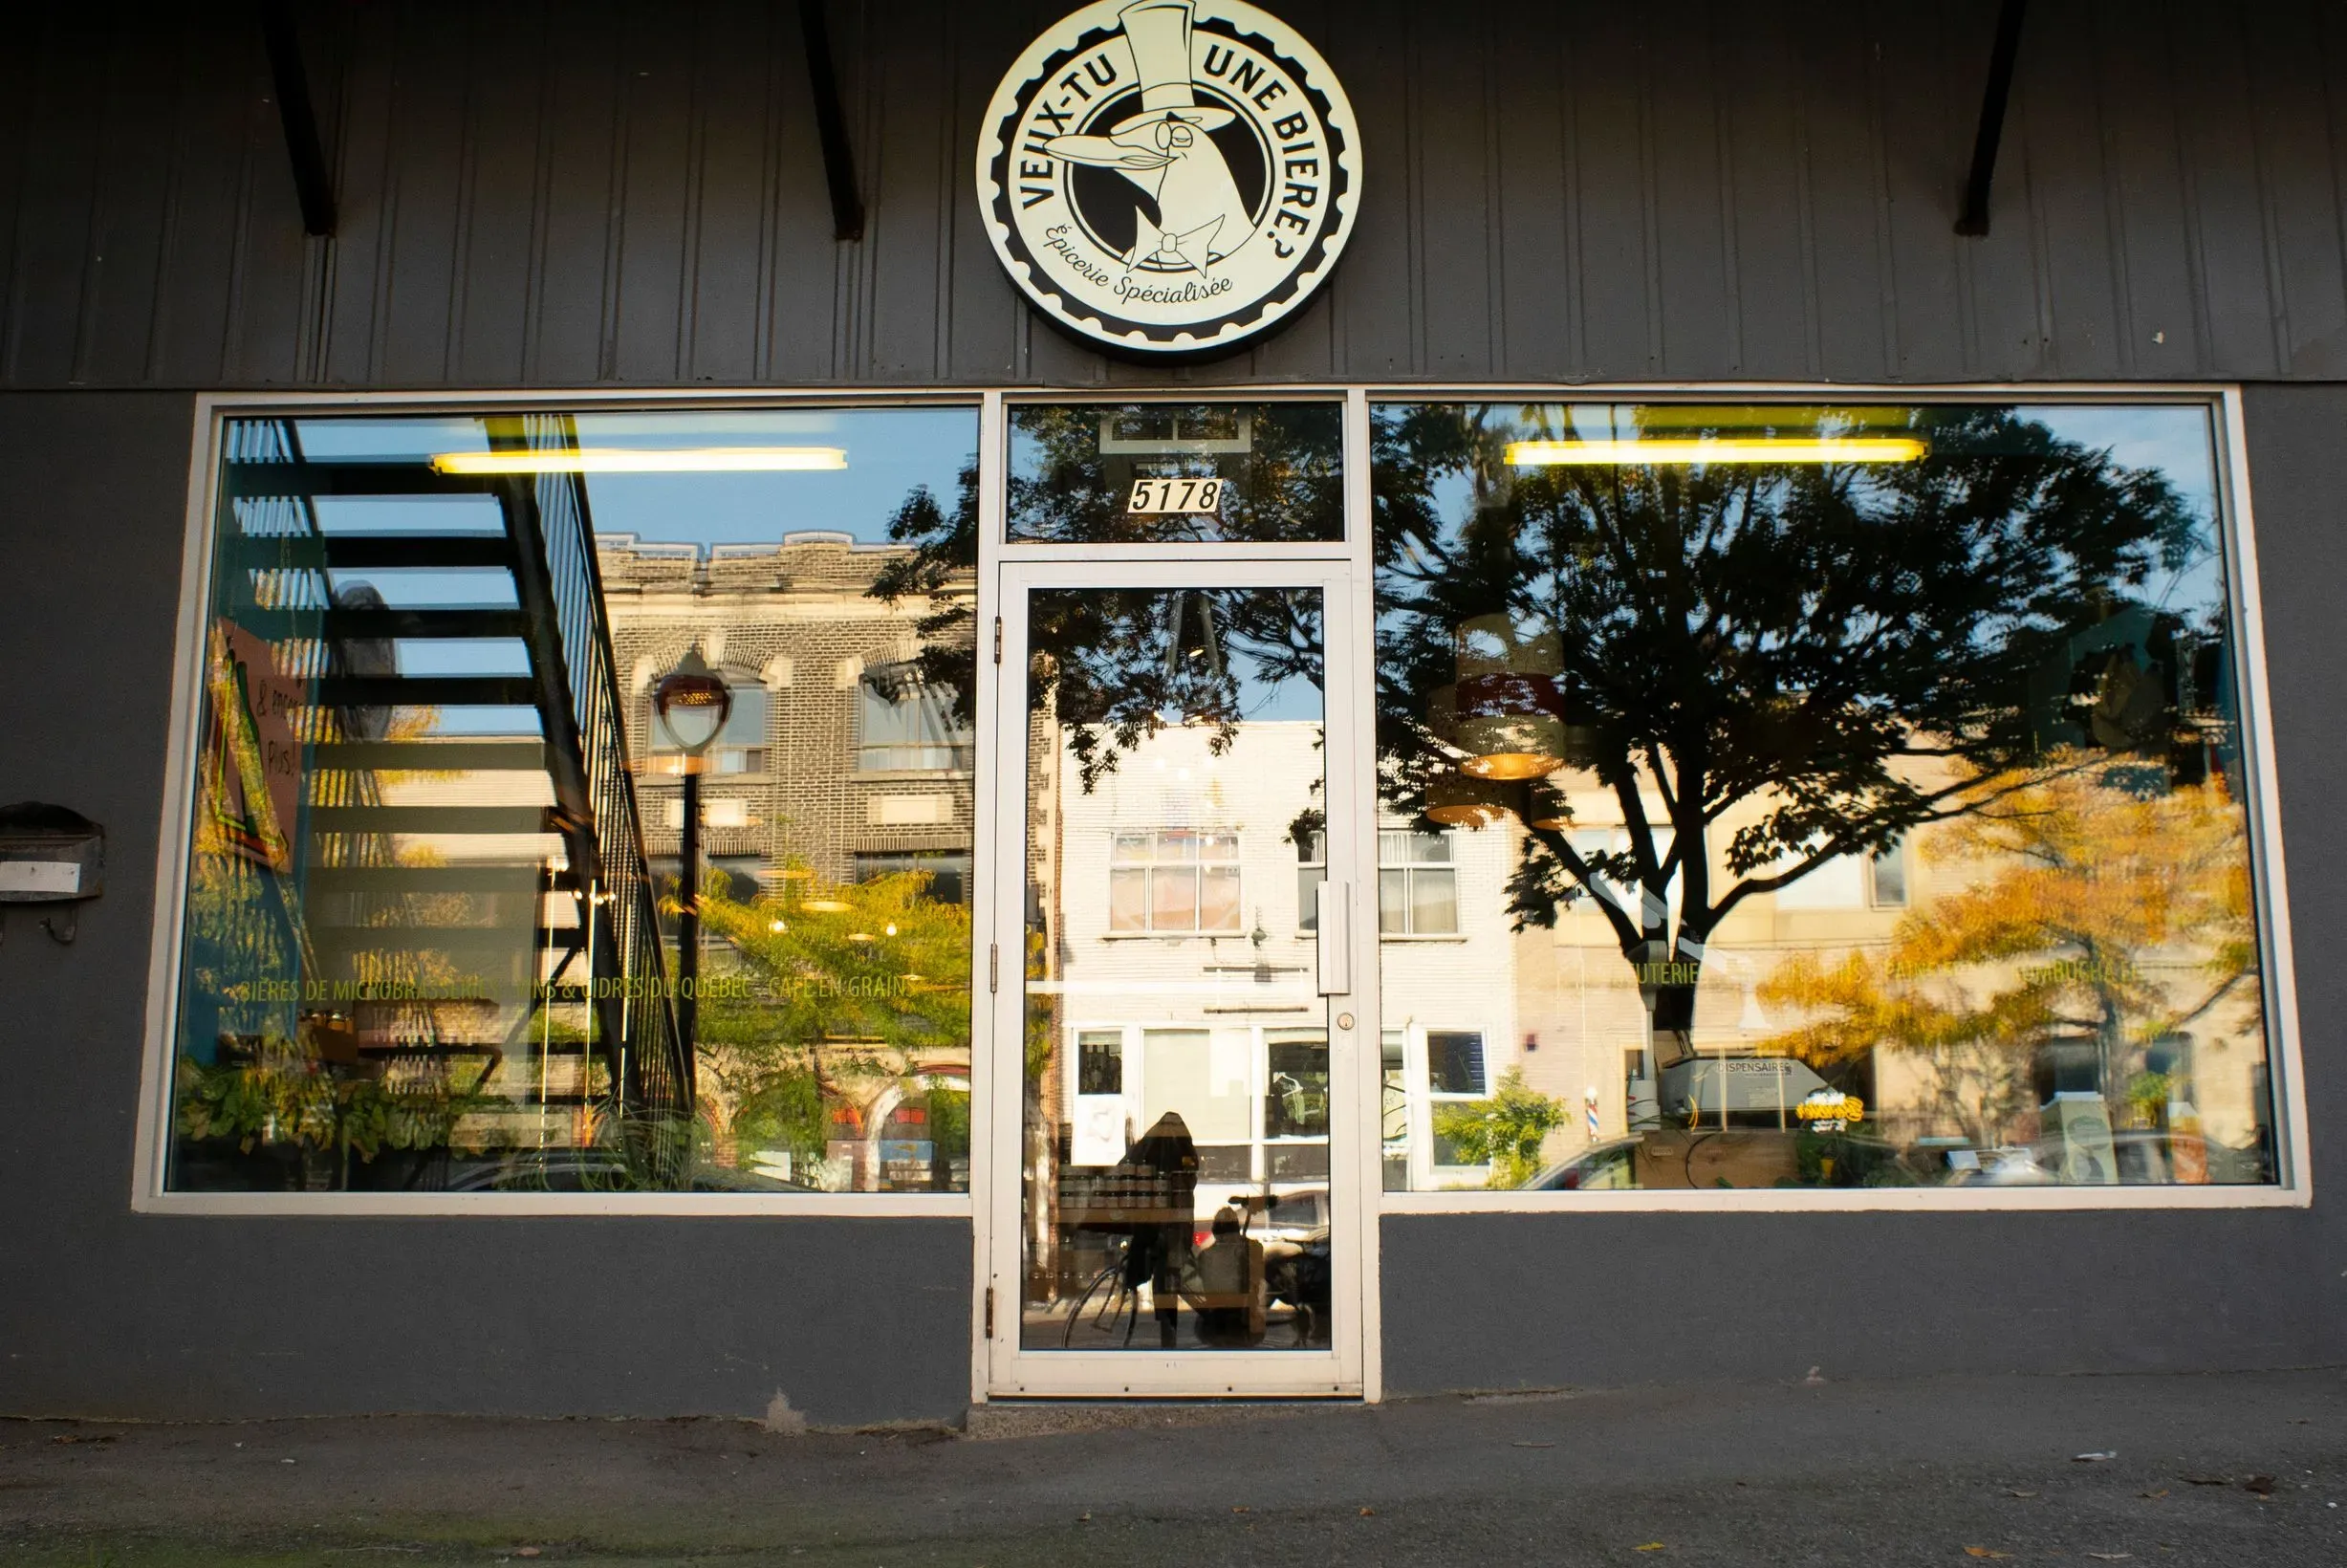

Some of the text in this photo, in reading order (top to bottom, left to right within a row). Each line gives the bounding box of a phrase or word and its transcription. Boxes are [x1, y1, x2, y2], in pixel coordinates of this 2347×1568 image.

[1204, 44, 1288, 111] UNE
[1267, 110, 1318, 258] BIERE?
[1043, 224, 1233, 305] Épicerie Spécialisée
[1132, 481, 1218, 510] 5178
[1633, 962, 1701, 985] UTERIE
[306, 979, 328, 1001] DE
[517, 977, 556, 1000] VNS
[561, 979, 576, 999] &
[581, 976, 643, 999] CIDRES
[650, 976, 675, 999] DU
[818, 976, 842, 998] EN
